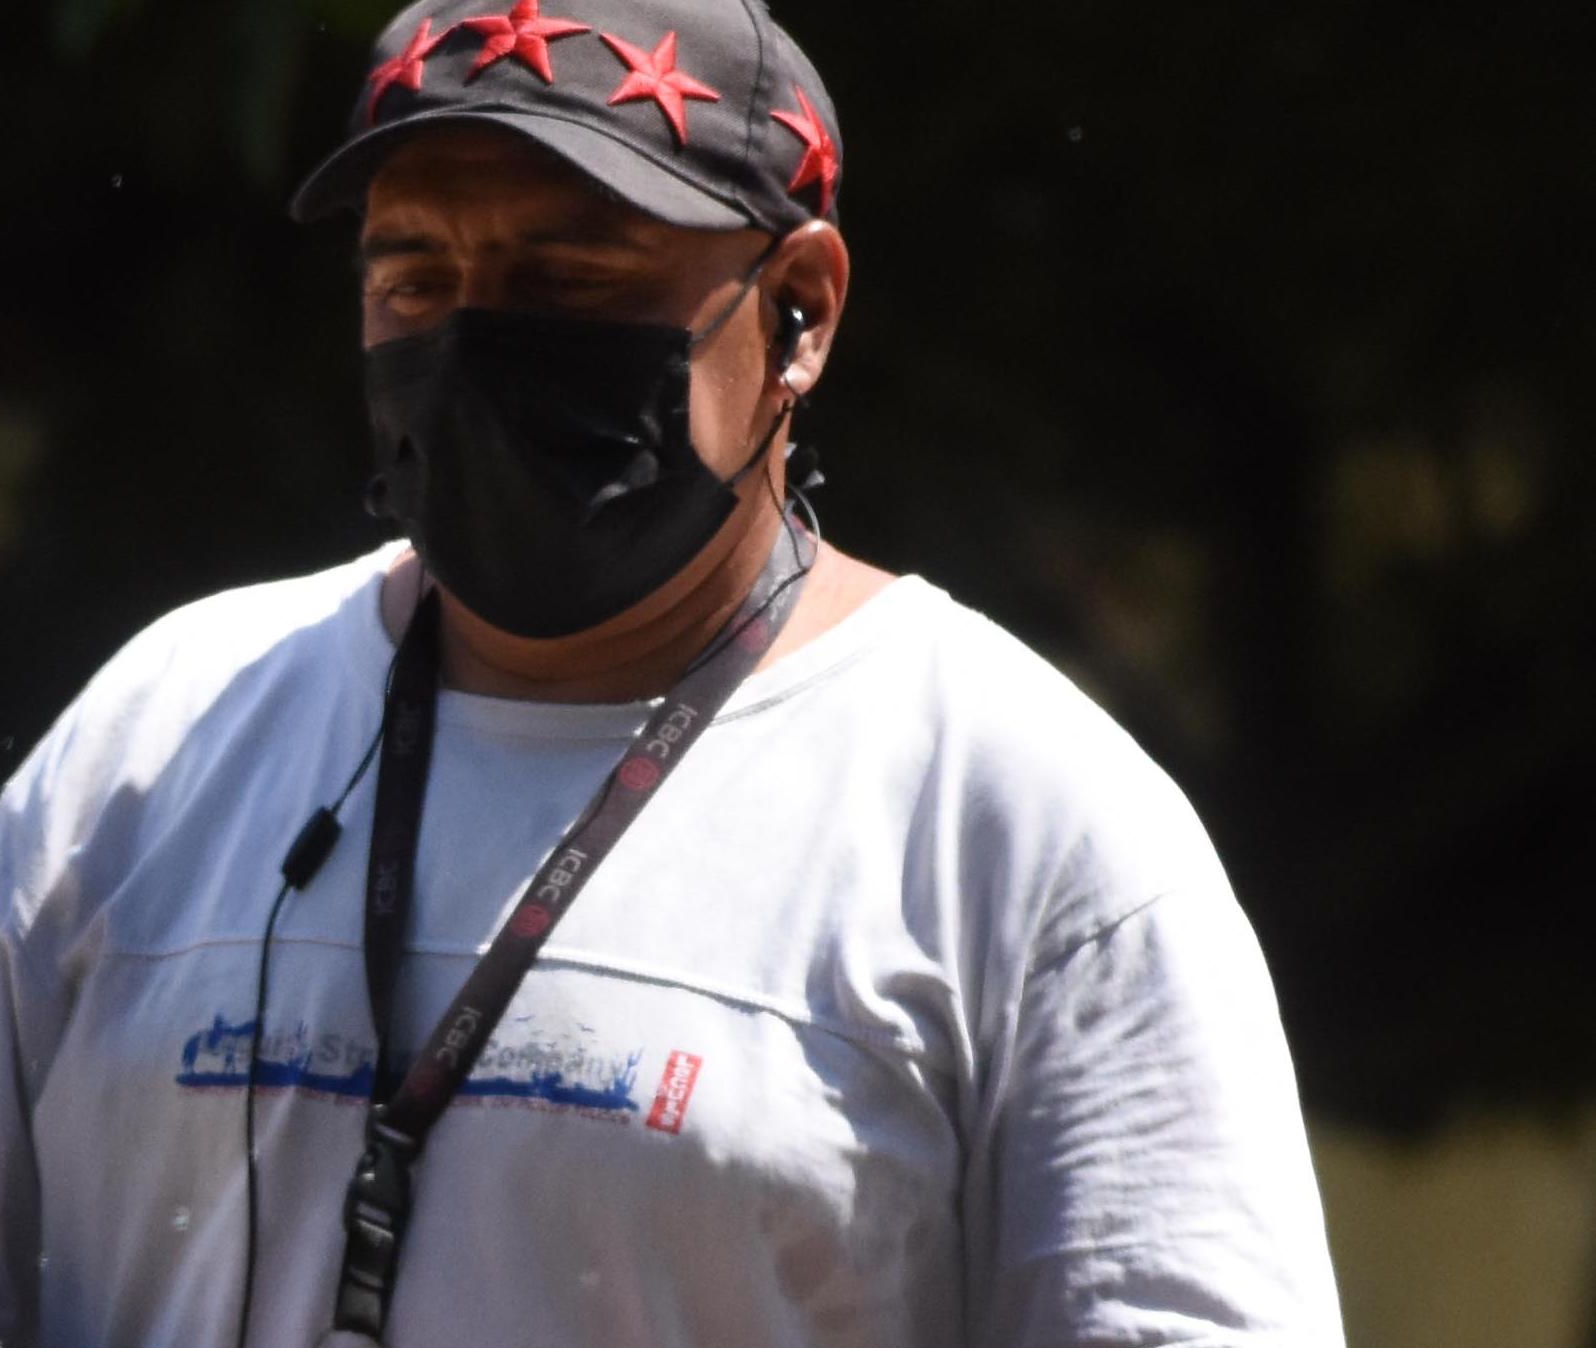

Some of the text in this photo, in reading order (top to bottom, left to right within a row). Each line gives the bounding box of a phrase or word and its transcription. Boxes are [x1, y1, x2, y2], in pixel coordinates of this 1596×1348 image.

[646, 703, 698, 759] ICBC
[374, 860, 400, 916] ICBC
[536, 848, 588, 906] ICBC
[436, 1005, 484, 1067] ICBC
